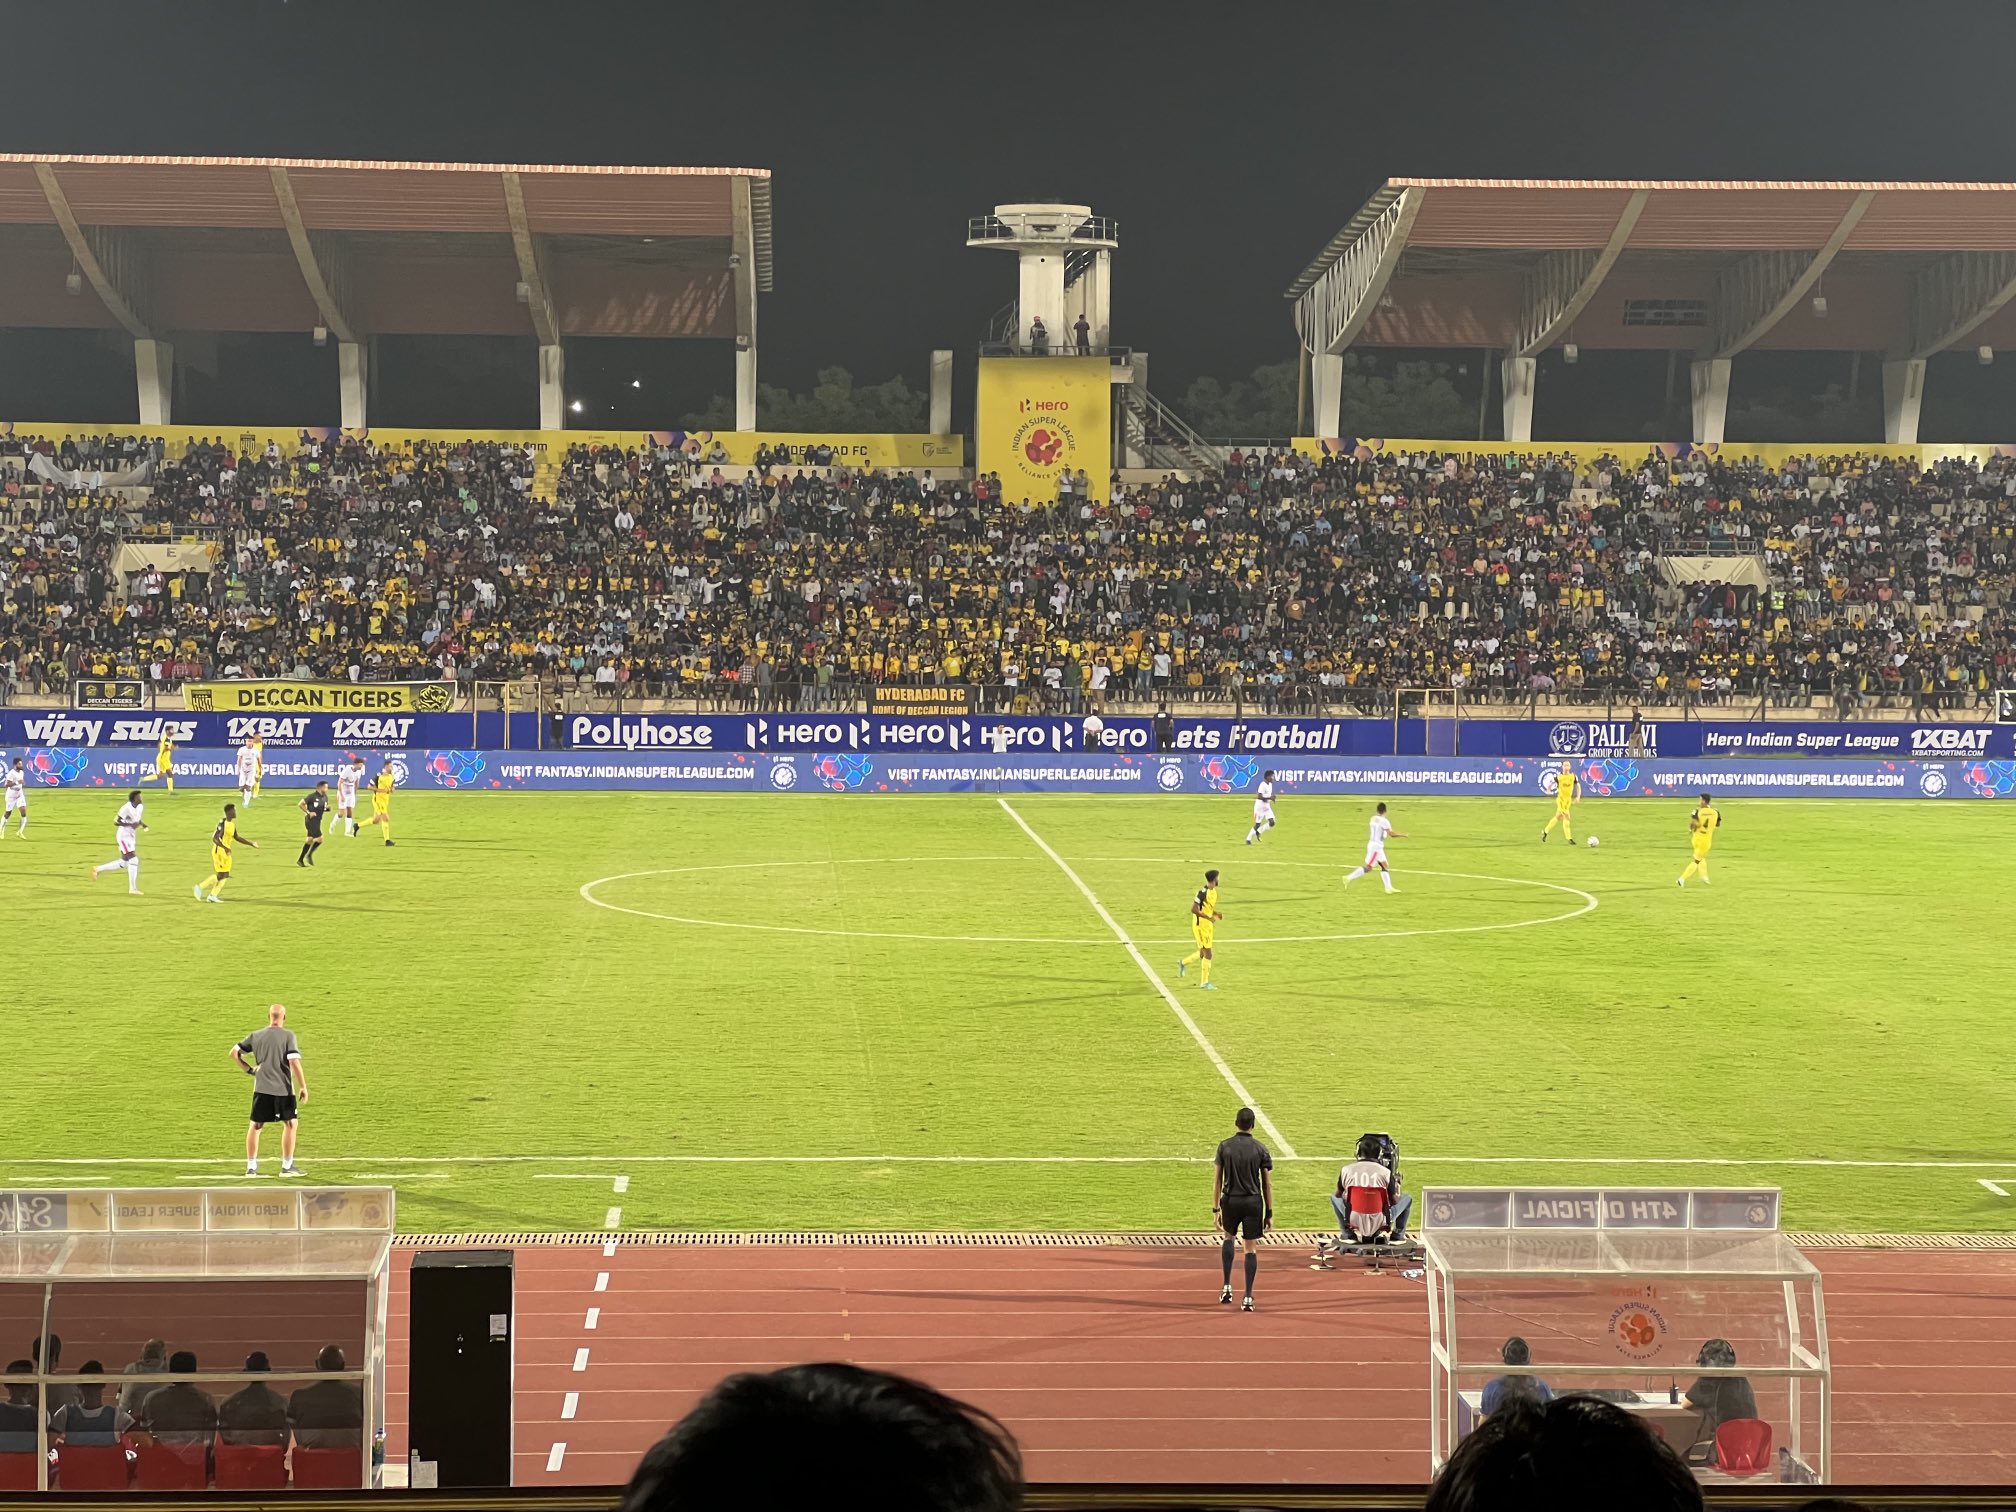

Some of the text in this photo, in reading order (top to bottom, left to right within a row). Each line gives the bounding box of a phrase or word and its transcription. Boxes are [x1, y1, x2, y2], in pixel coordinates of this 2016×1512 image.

[1035, 401, 1069, 411] Hero
[1012, 416, 1076, 452] INDIAN SUPER LEAGUE
[852, 446, 868, 456] FC
[167, 547, 177, 558] E
[238, 688, 403, 708] DECCAN TIGERS
[875, 687, 966, 702] HYDERABAD FC
[872, 705, 969, 716] HOME OF DECCAN LEGION
[226, 717, 311, 738] 1XBAT
[331, 718, 415, 738] 1XBAT
[572, 716, 713, 751] Polyhose
[778, 724, 843, 744] Hero
[880, 724, 945, 744] Hero
[227, 738, 303, 746] 1XBATRTING.COM
[332, 738, 407, 747] 1XBATSPORTING.COM
[1083, 727, 1148, 747] ero
[1229, 724, 1341, 750] Football
[1588, 724, 1657, 747] PALLVI
[1706, 732, 1900, 751] Hero Indian Super League
[1911, 729, 1993, 749] 1XBAT
[1588, 748, 1658, 759] GROUP OF SHOLS
[1911, 749, 1984, 757] 1XBATSPORTING.COM
[104, 762, 139, 776] VISIT
[500, 765, 532, 778] VISIT
[535, 765, 754, 780] FANTASY.INDIANSUPERLEAGUE.COM
[887, 768, 920, 780] VISIT
[1273, 770, 1306, 783] VISIT
[1307, 770, 1523, 784] FANTASY.INDIANSUPERLEAGUE.COM
[1653, 773, 1685, 786] VISIT
[1687, 773, 1905, 788] FANTASY.INDIANSUPERLEAGUE.COM
[1353, 1171, 1378, 1188] 101
